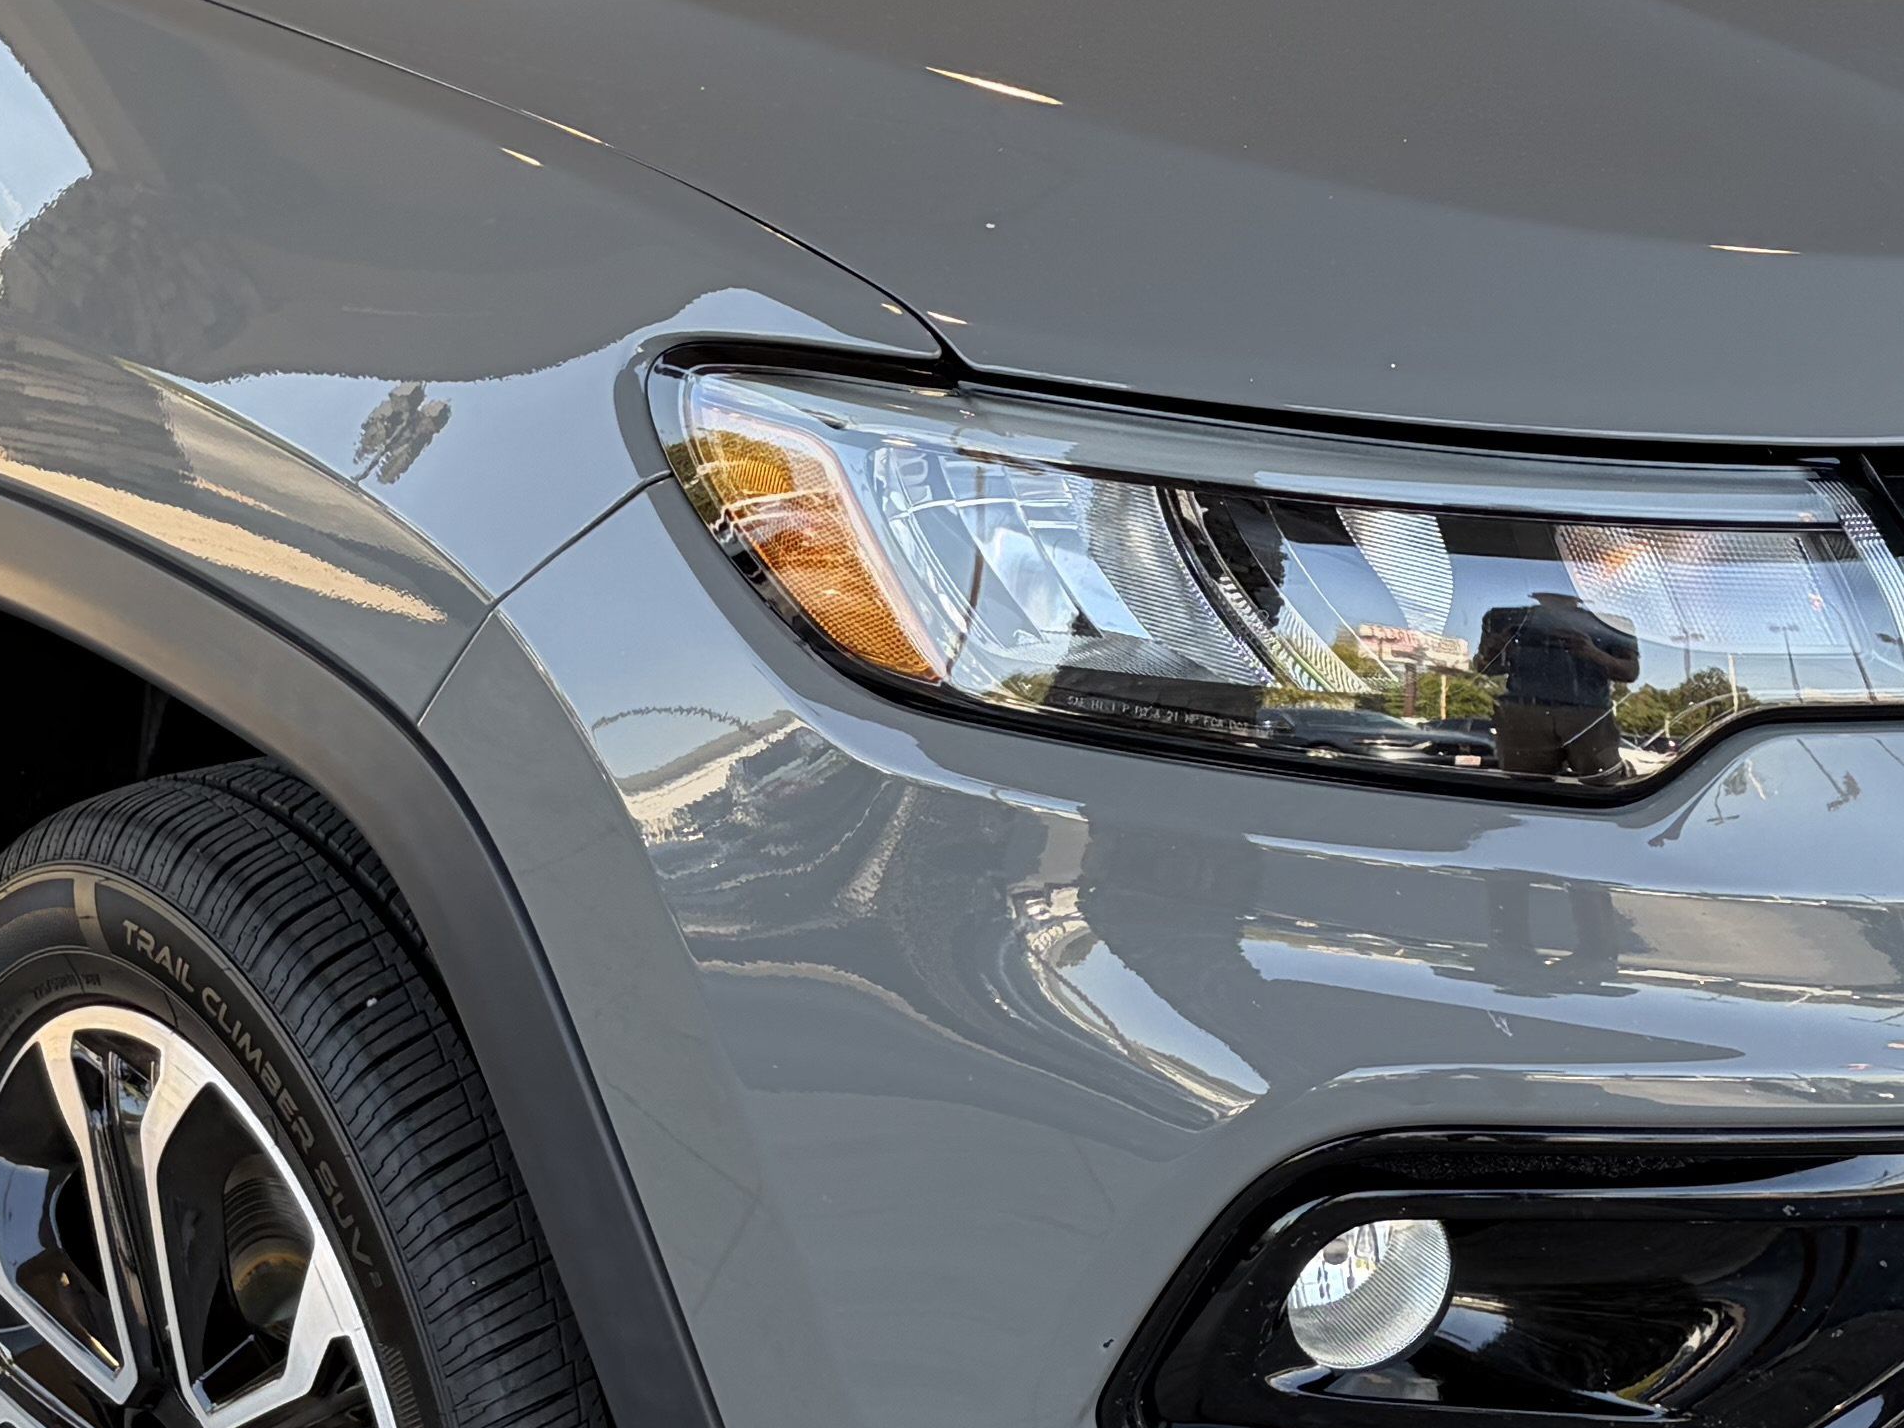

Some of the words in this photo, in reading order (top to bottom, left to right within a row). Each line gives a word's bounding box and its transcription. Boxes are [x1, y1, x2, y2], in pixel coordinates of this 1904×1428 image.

[122, 920, 194, 993] TRAIL
[201, 987, 314, 1155] CLIMBER
[314, 1160, 374, 1266] SUV
